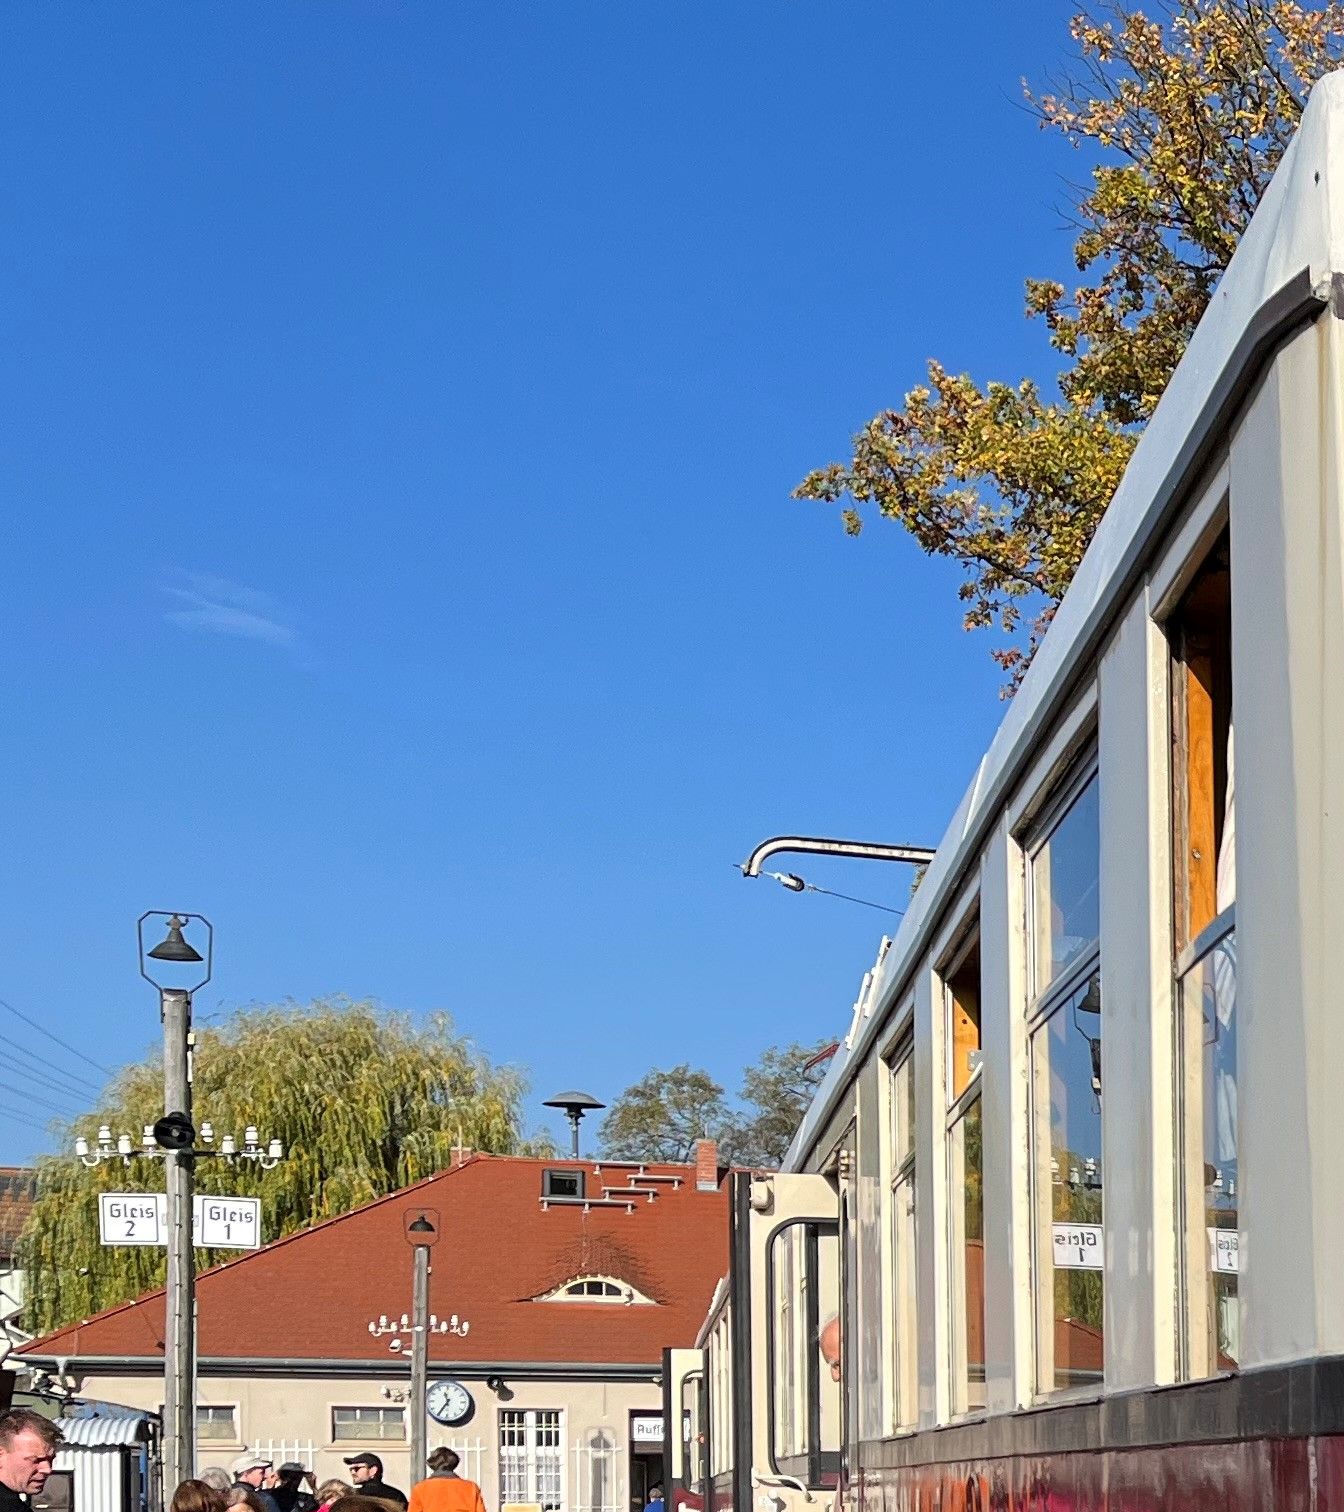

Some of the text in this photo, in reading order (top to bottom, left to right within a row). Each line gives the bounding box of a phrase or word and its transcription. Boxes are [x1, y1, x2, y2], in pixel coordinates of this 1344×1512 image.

[110, 1203, 154, 1218] Gleis
[209, 1206, 253, 1223] Gleis
[125, 1220, 136, 1237] 2
[224, 1223, 231, 1240] 1
